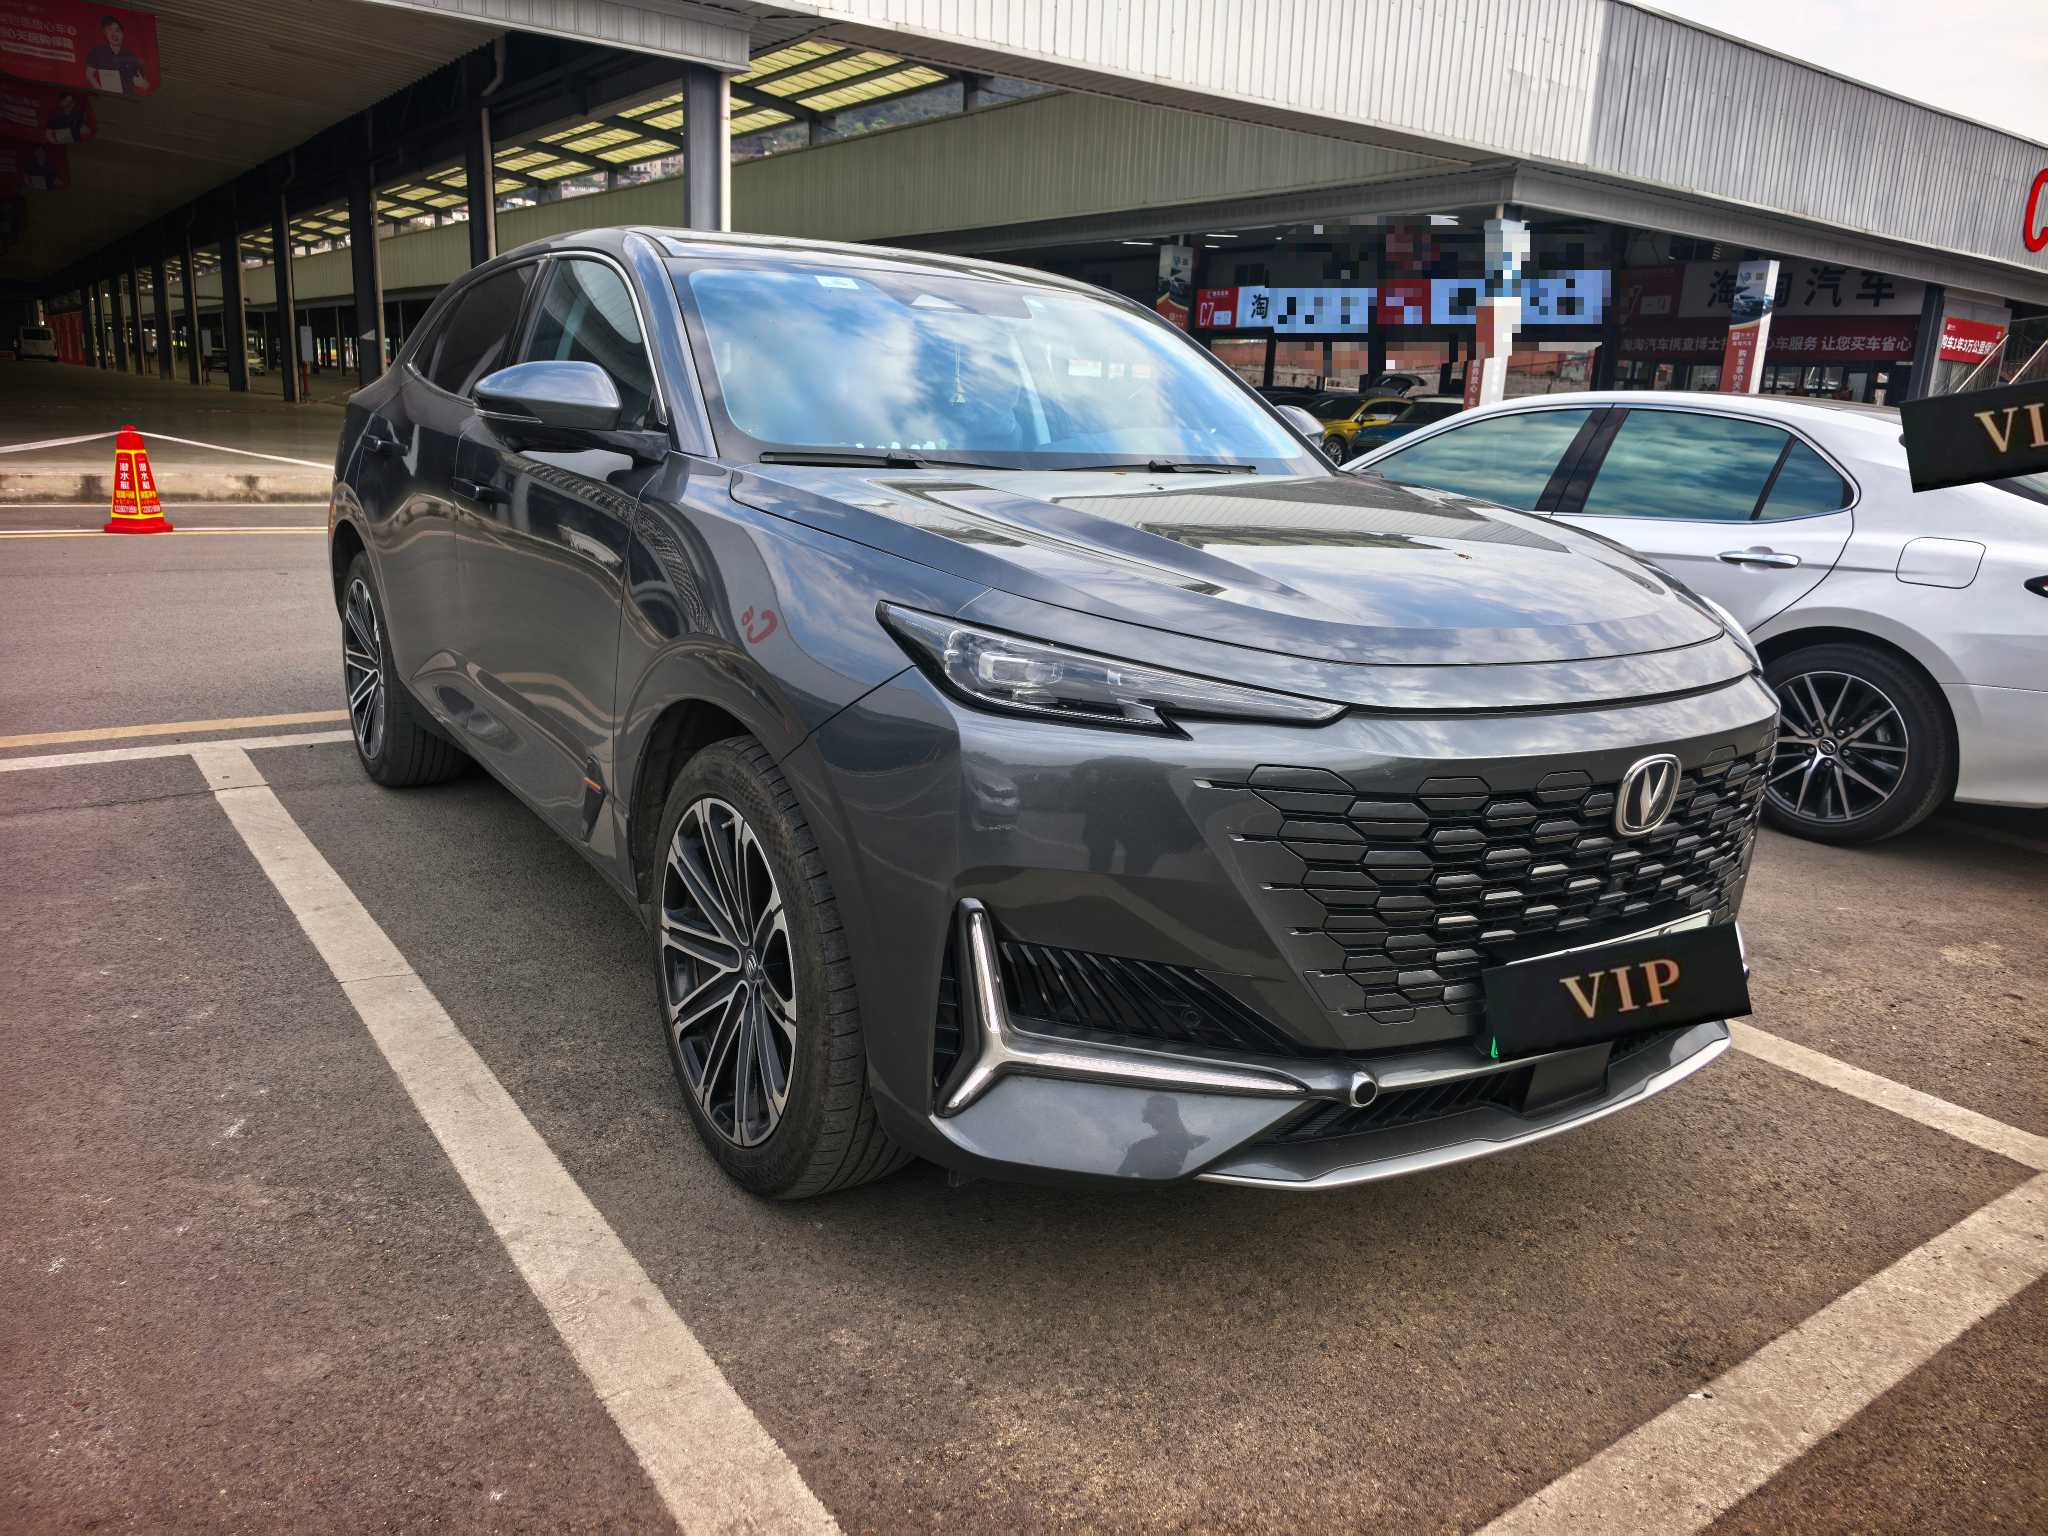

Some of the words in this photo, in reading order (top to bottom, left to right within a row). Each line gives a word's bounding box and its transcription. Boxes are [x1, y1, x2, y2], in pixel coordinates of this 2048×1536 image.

[1821, 336, 1912, 353] 让您买车省心
